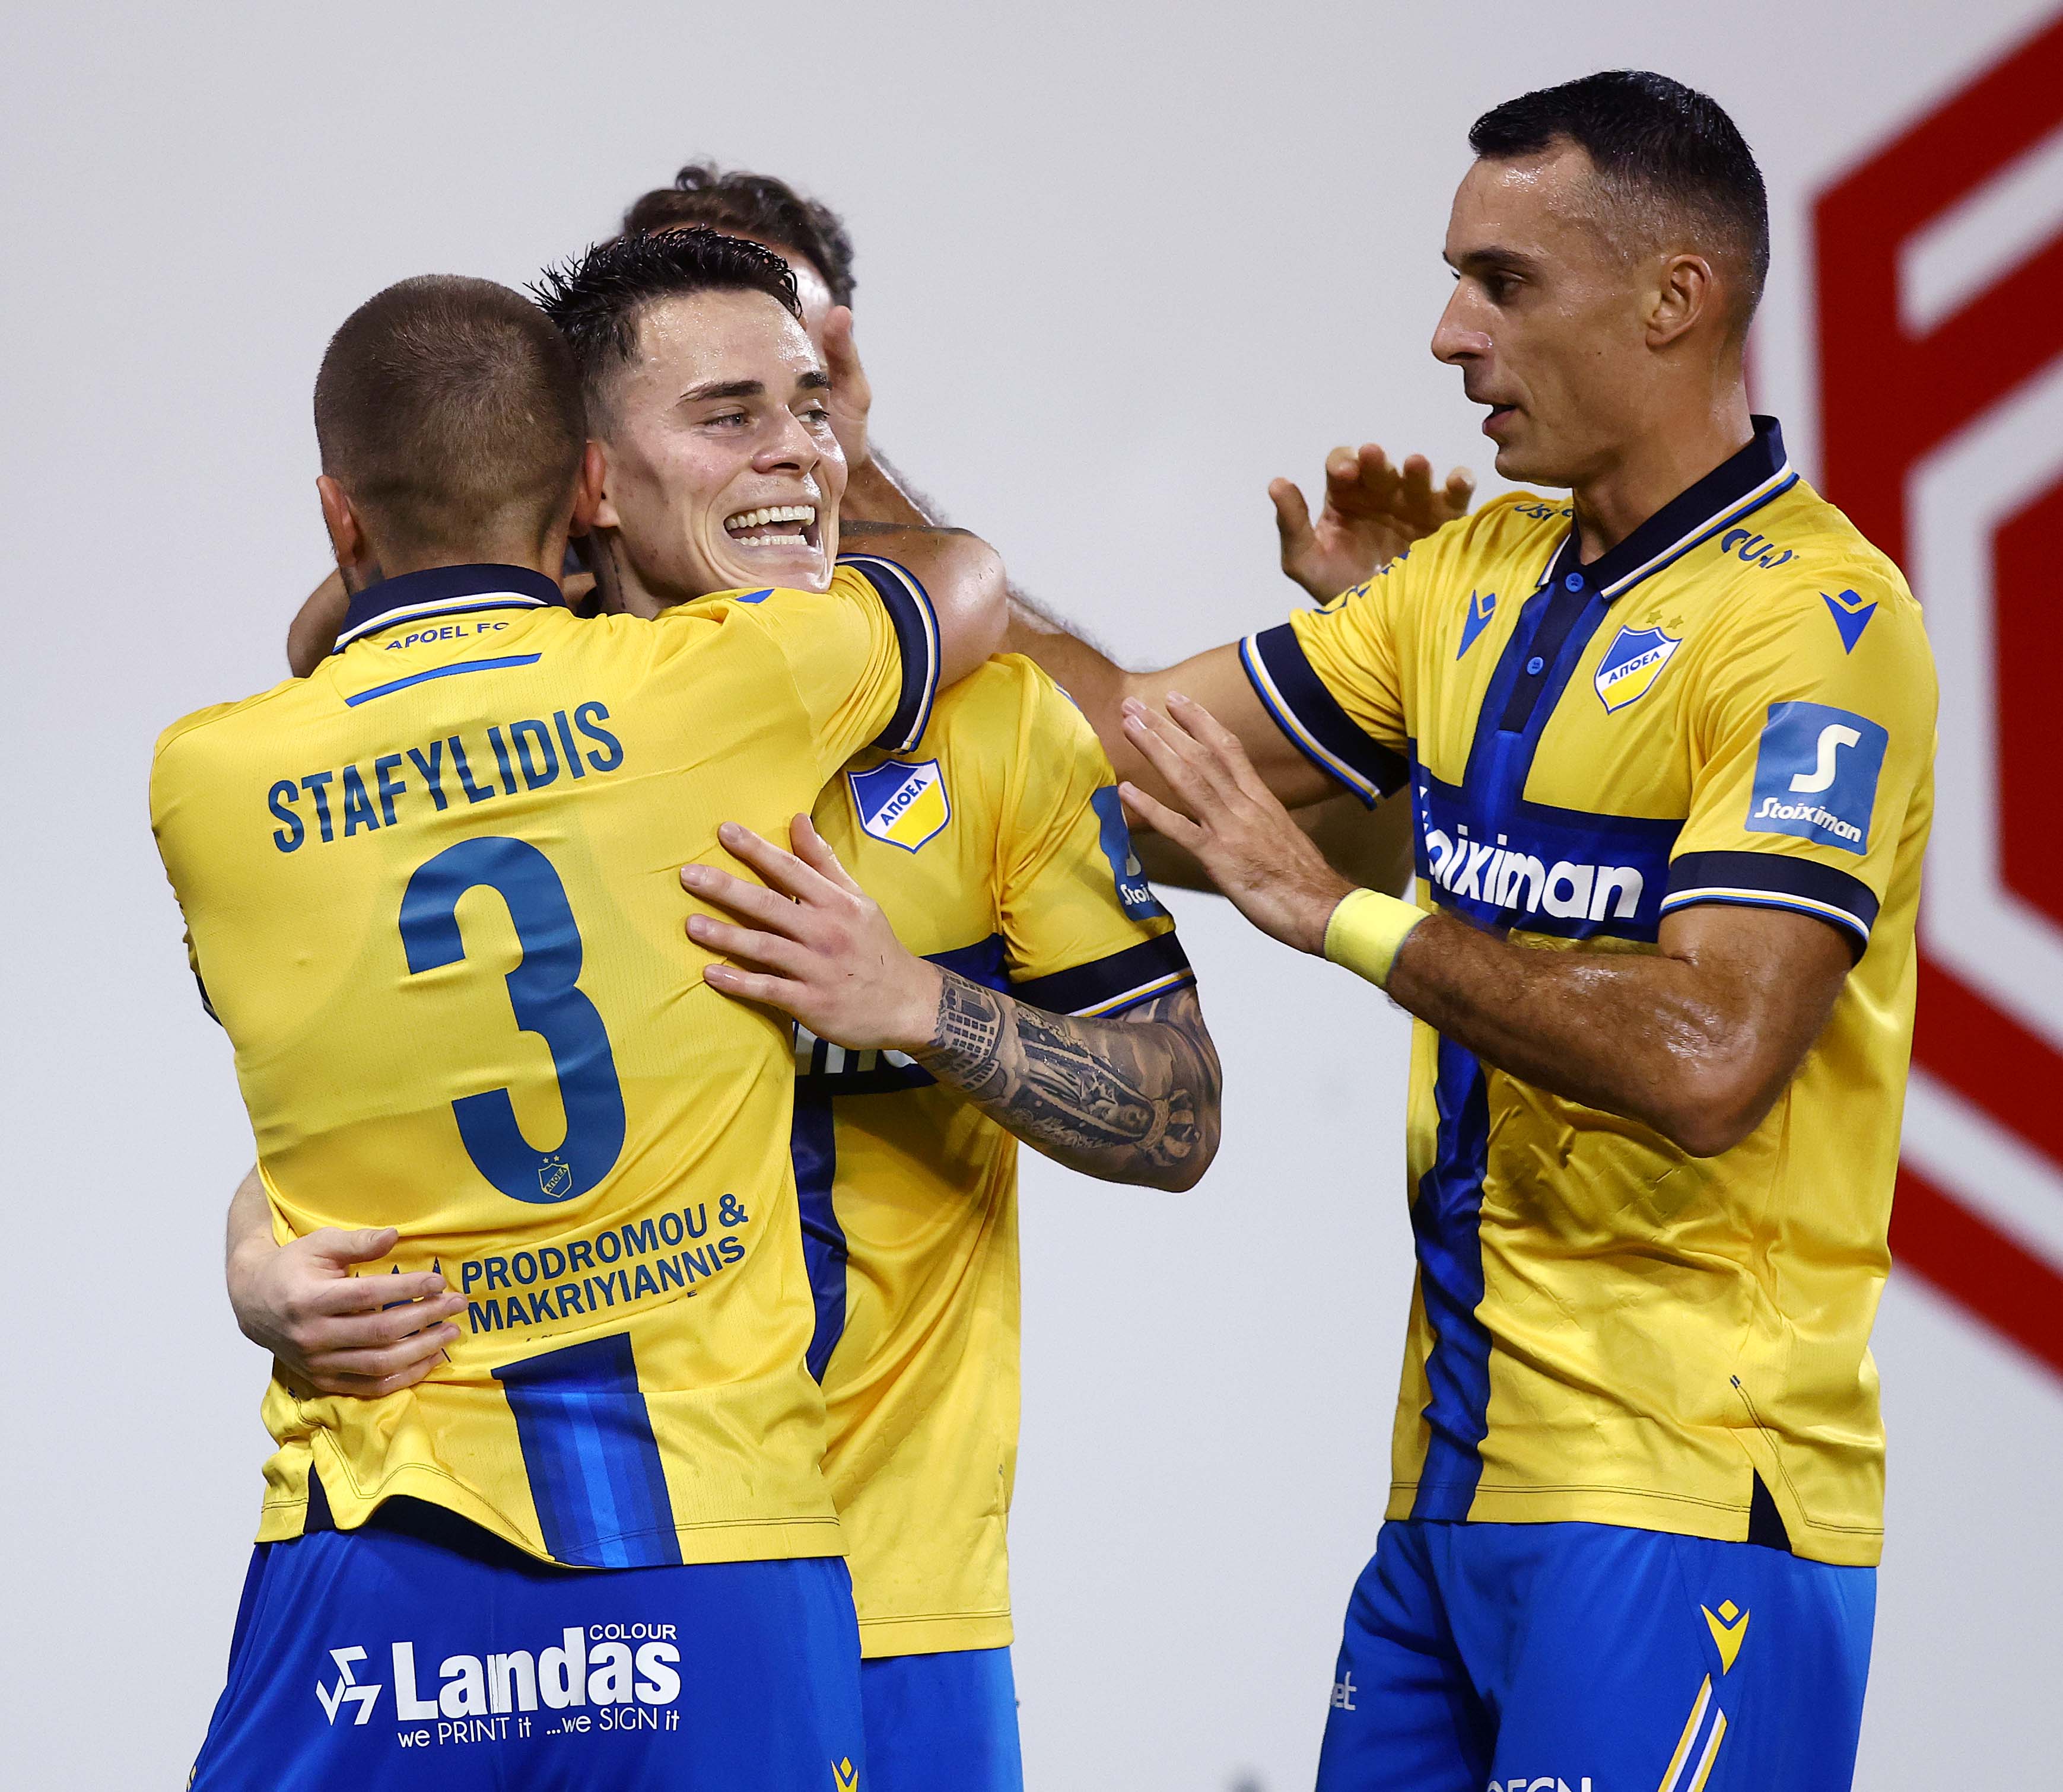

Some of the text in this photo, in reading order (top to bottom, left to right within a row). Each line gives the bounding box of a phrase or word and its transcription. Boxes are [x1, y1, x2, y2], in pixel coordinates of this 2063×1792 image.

[384, 623, 510, 651] APOEL FC
[1609, 651, 1661, 684] ΑΠΟΕΛ
[268, 701, 624, 853] STAFYLIDIS
[880, 778, 928, 826] ΑΠΟΕΛ
[1754, 797, 1862, 842] Stoiximan
[1420, 810, 1644, 921] oiximan
[399, 836, 626, 1204] 3
[462, 1193, 749, 1294] PRODROMOU &
[468, 1236, 745, 1333] MAKRIYIANNIS
[589, 1623, 677, 1640] COLOUR
[392, 1627, 681, 1721] Landas
[398, 1730, 430, 1748] we
[438, 1717, 510, 1745] PRINT
[518, 1717, 532, 1737] it
[599, 1707, 657, 1730] SIGN
[666, 1710, 680, 1730] it
